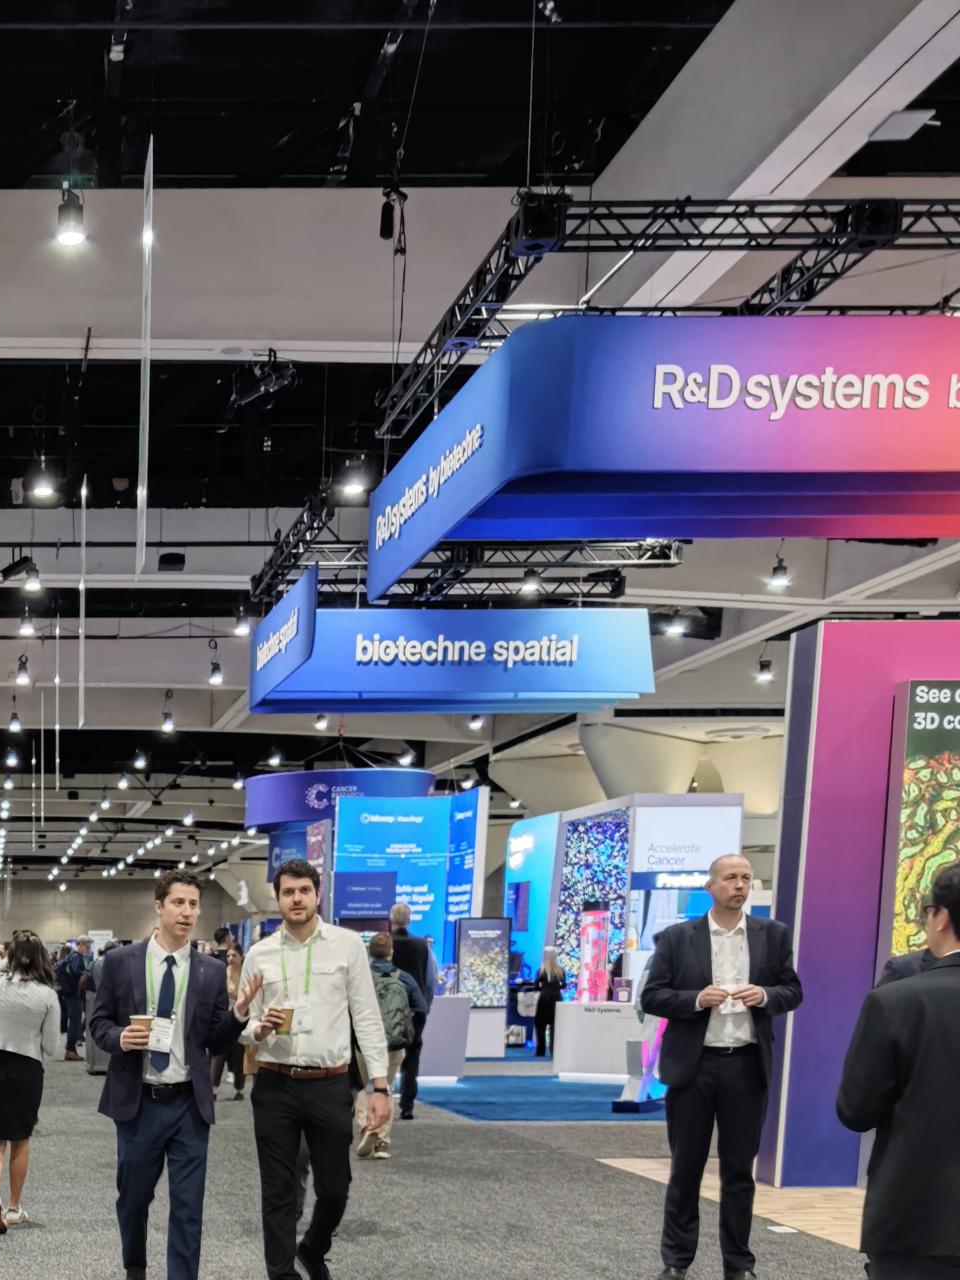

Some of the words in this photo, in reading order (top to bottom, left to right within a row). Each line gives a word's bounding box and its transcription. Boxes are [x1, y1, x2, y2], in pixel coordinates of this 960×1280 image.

[653, 364, 740, 409] R&D
[745, 367, 930, 421] systems
[391, 474, 427, 538] systems
[429, 466, 440, 498] by
[355, 633, 486, 662] biotechne
[492, 634, 580, 668] spatial
[915, 685, 952, 704] See
[913, 712, 940, 730] 3D
[647, 842, 701, 854] Accelerate
[647, 854, 686, 866] Cancer
